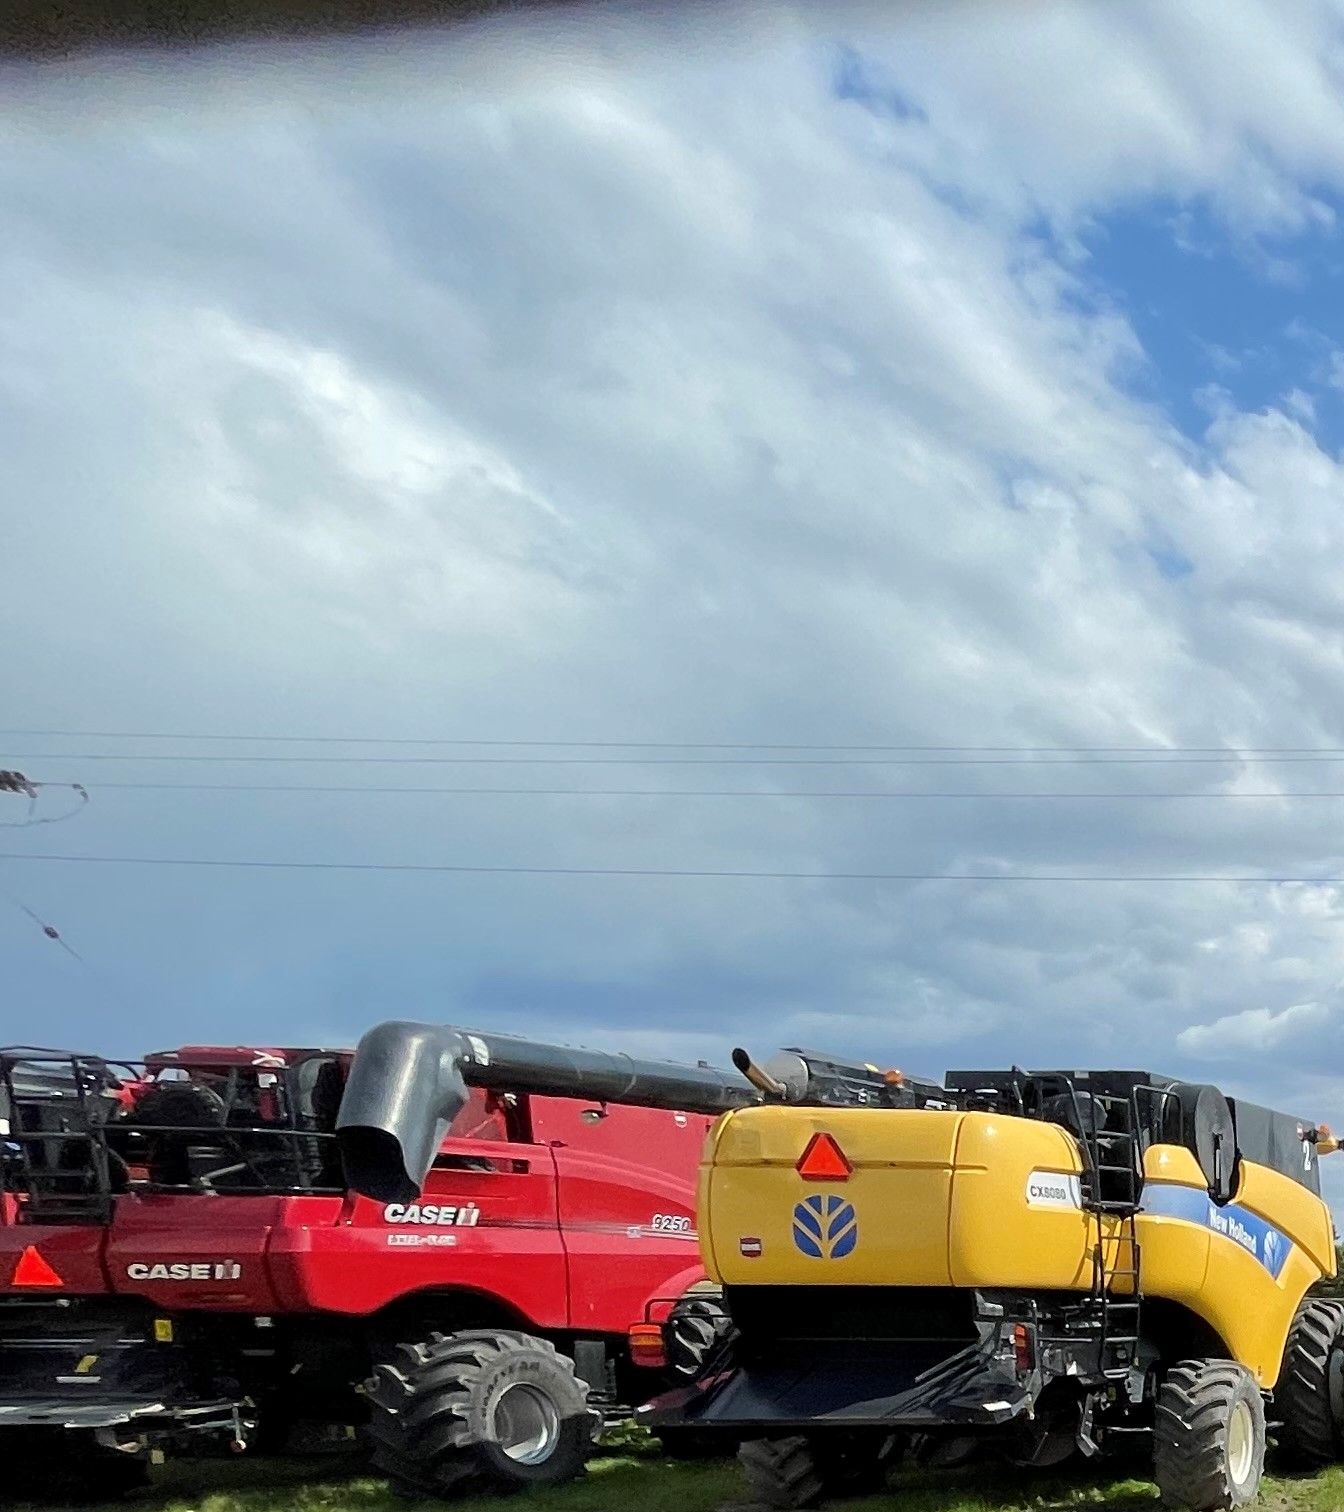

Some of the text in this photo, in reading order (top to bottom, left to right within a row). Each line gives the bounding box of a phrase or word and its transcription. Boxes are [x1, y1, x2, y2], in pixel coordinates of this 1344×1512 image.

[1302, 1140, 1312, 1171] 2
[383, 1203, 457, 1226] CASE
[652, 1213, 692, 1232] 9250
[1209, 1206, 1257, 1254] New Holland
[127, 1263, 211, 1280] CASE
